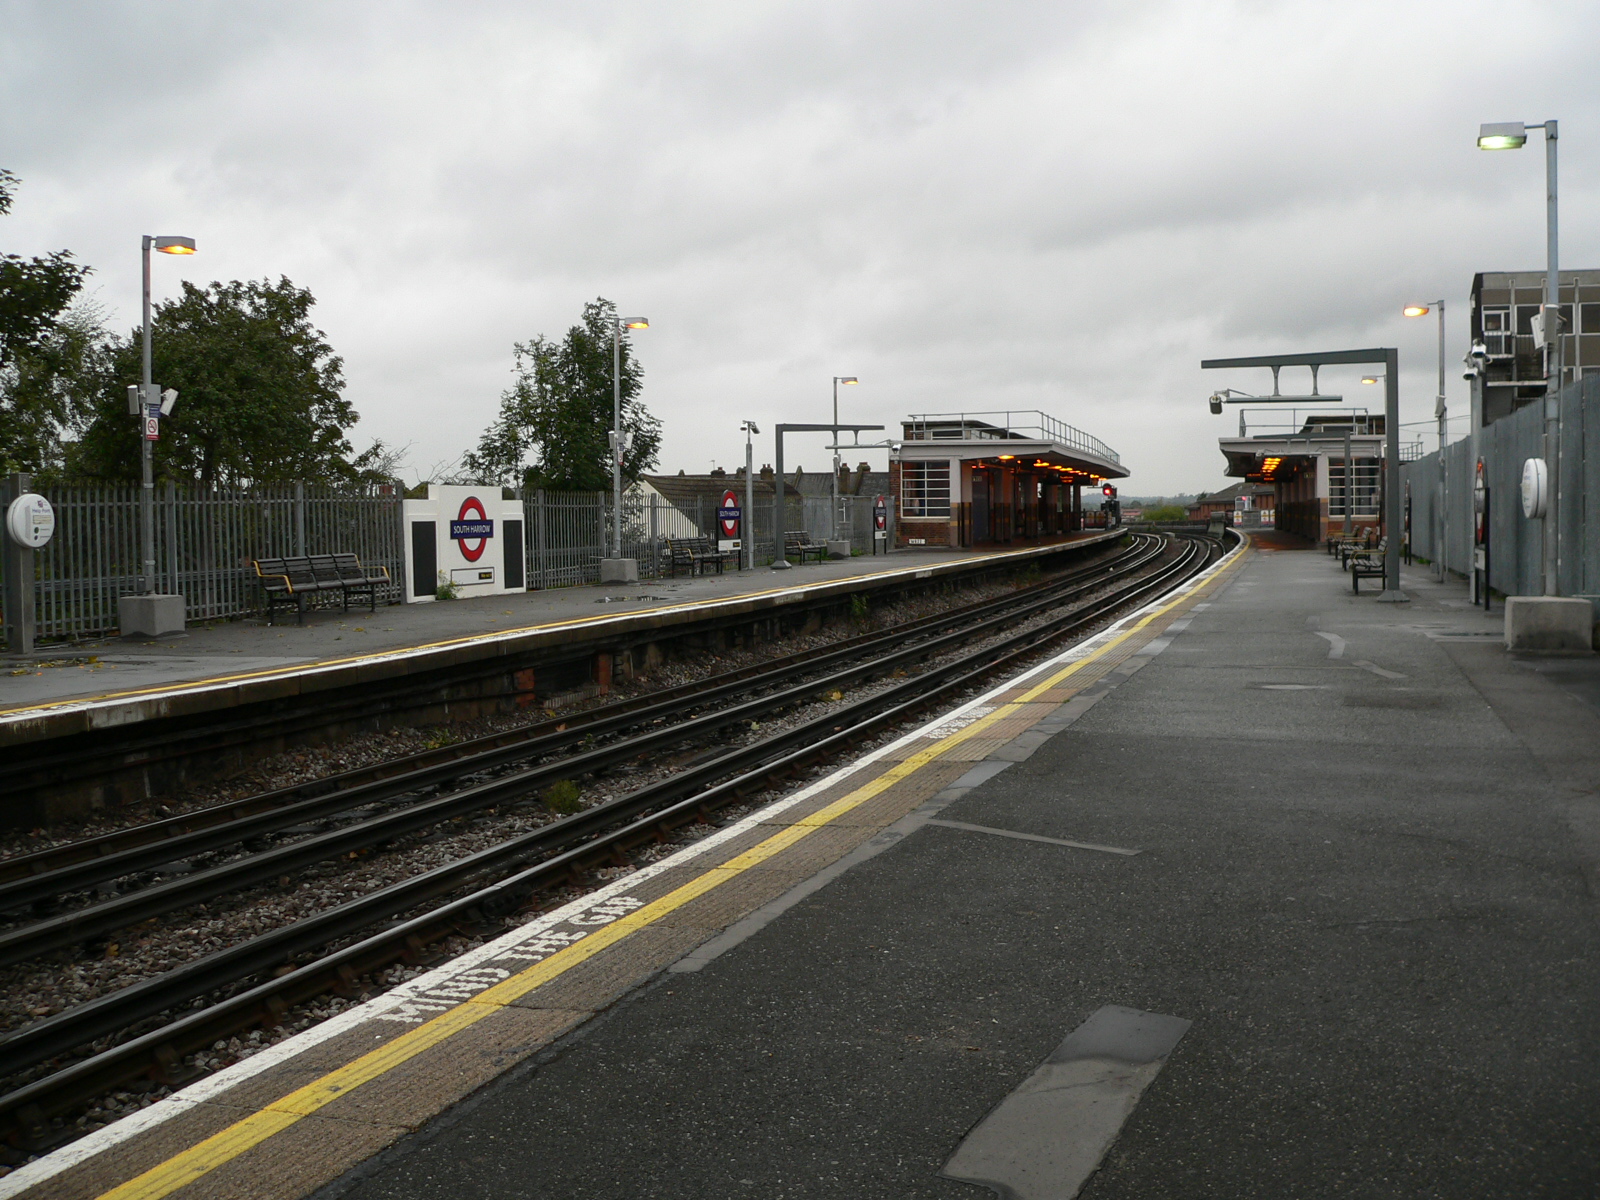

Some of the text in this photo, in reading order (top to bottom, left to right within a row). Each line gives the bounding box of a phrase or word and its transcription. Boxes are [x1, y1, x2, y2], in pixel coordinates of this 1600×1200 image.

[453, 524, 491, 534] SOUTH HARROW
[374, 895, 646, 1024] MIND THE GAP
